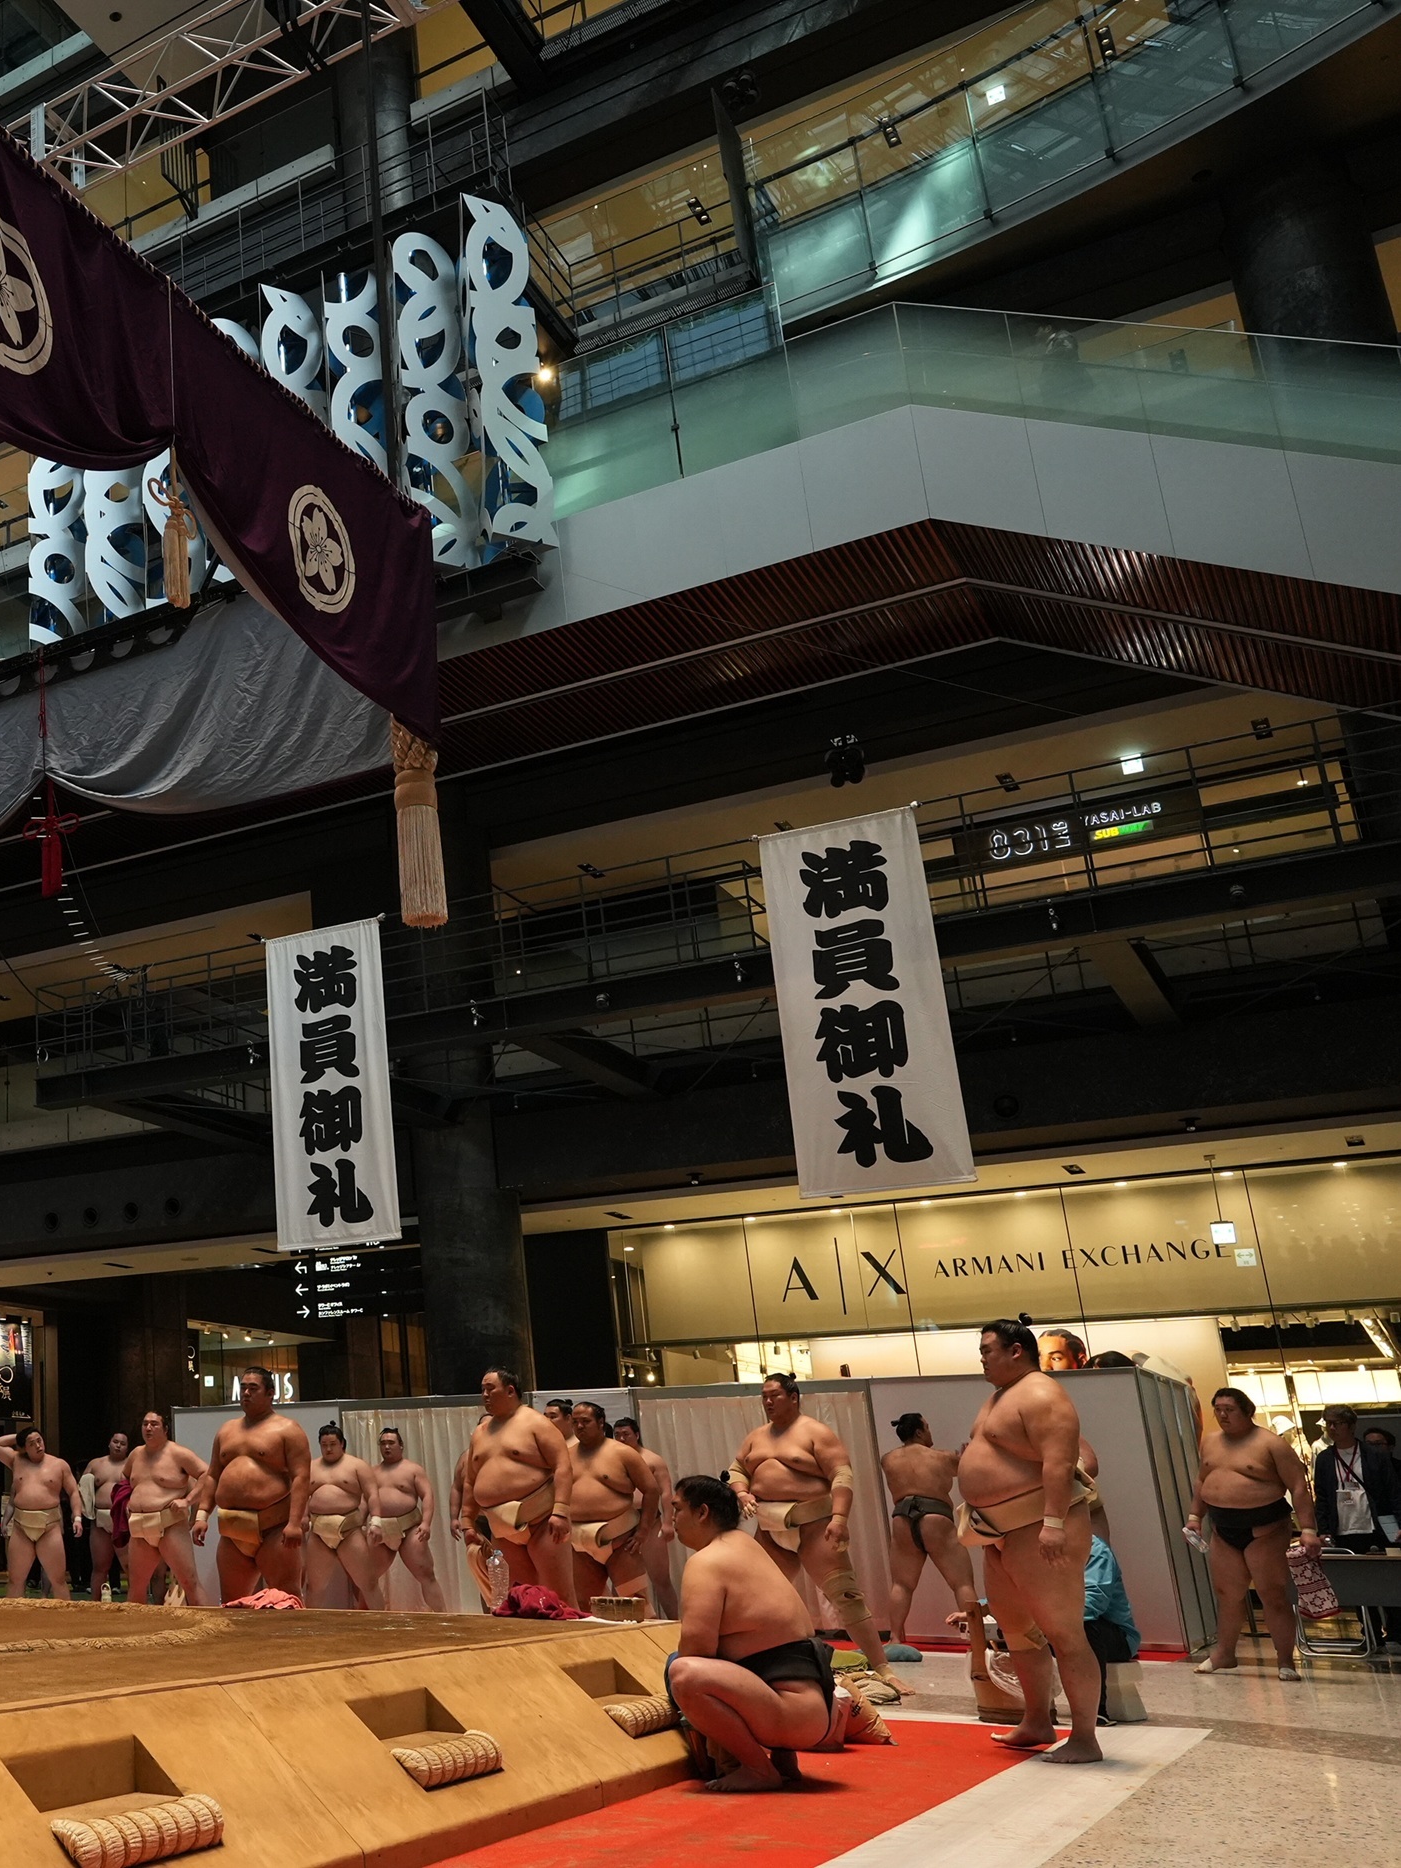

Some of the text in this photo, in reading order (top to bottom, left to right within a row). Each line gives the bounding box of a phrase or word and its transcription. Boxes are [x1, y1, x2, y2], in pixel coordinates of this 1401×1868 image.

[1080, 802, 1162, 827] YASAI-LAB
[799, 840, 934, 1168] 満員御礼
[293, 945, 374, 1228] 満員御礼
[934, 1238, 1231, 1279] ARMANI EXCHANGE
